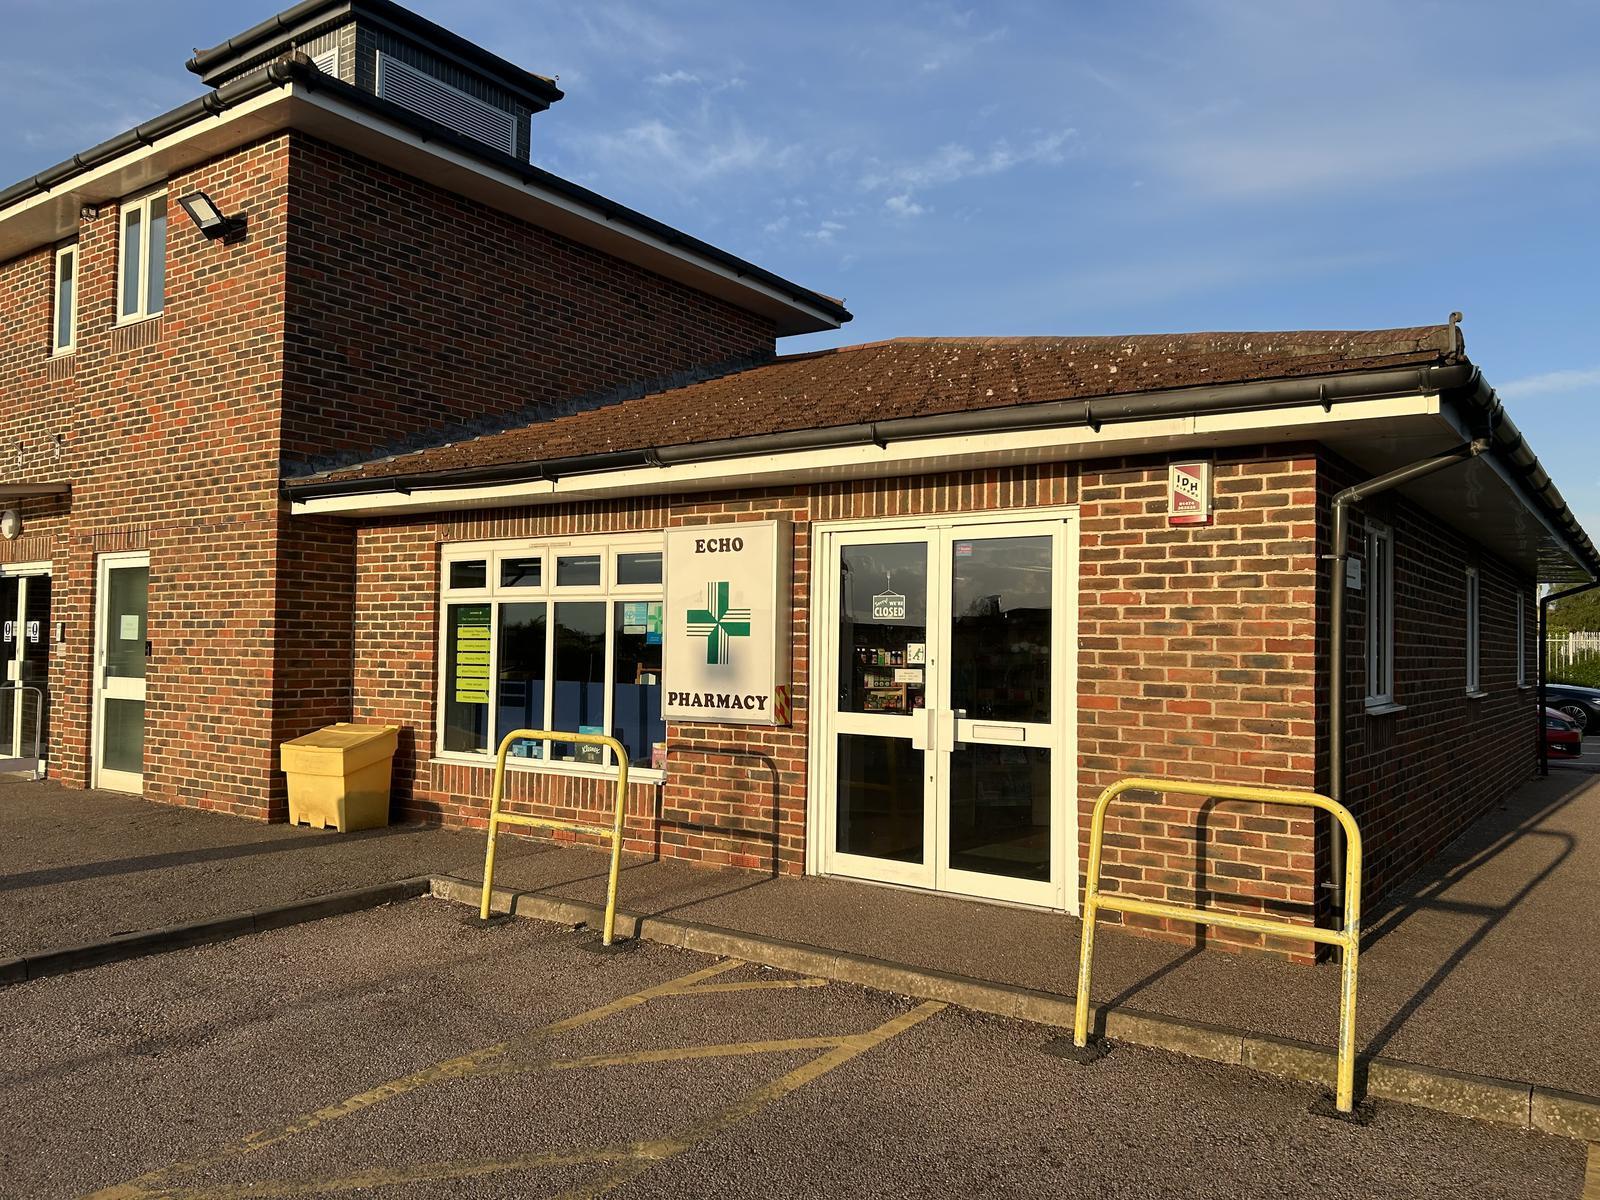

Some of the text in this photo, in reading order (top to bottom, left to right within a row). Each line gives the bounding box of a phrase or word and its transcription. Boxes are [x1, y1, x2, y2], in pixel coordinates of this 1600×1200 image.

[1177, 475, 1198, 491] IDH
[695, 537, 744, 554] ECHO
[874, 607, 904, 617] CLOSED
[667, 691, 769, 710] PHARMACY
